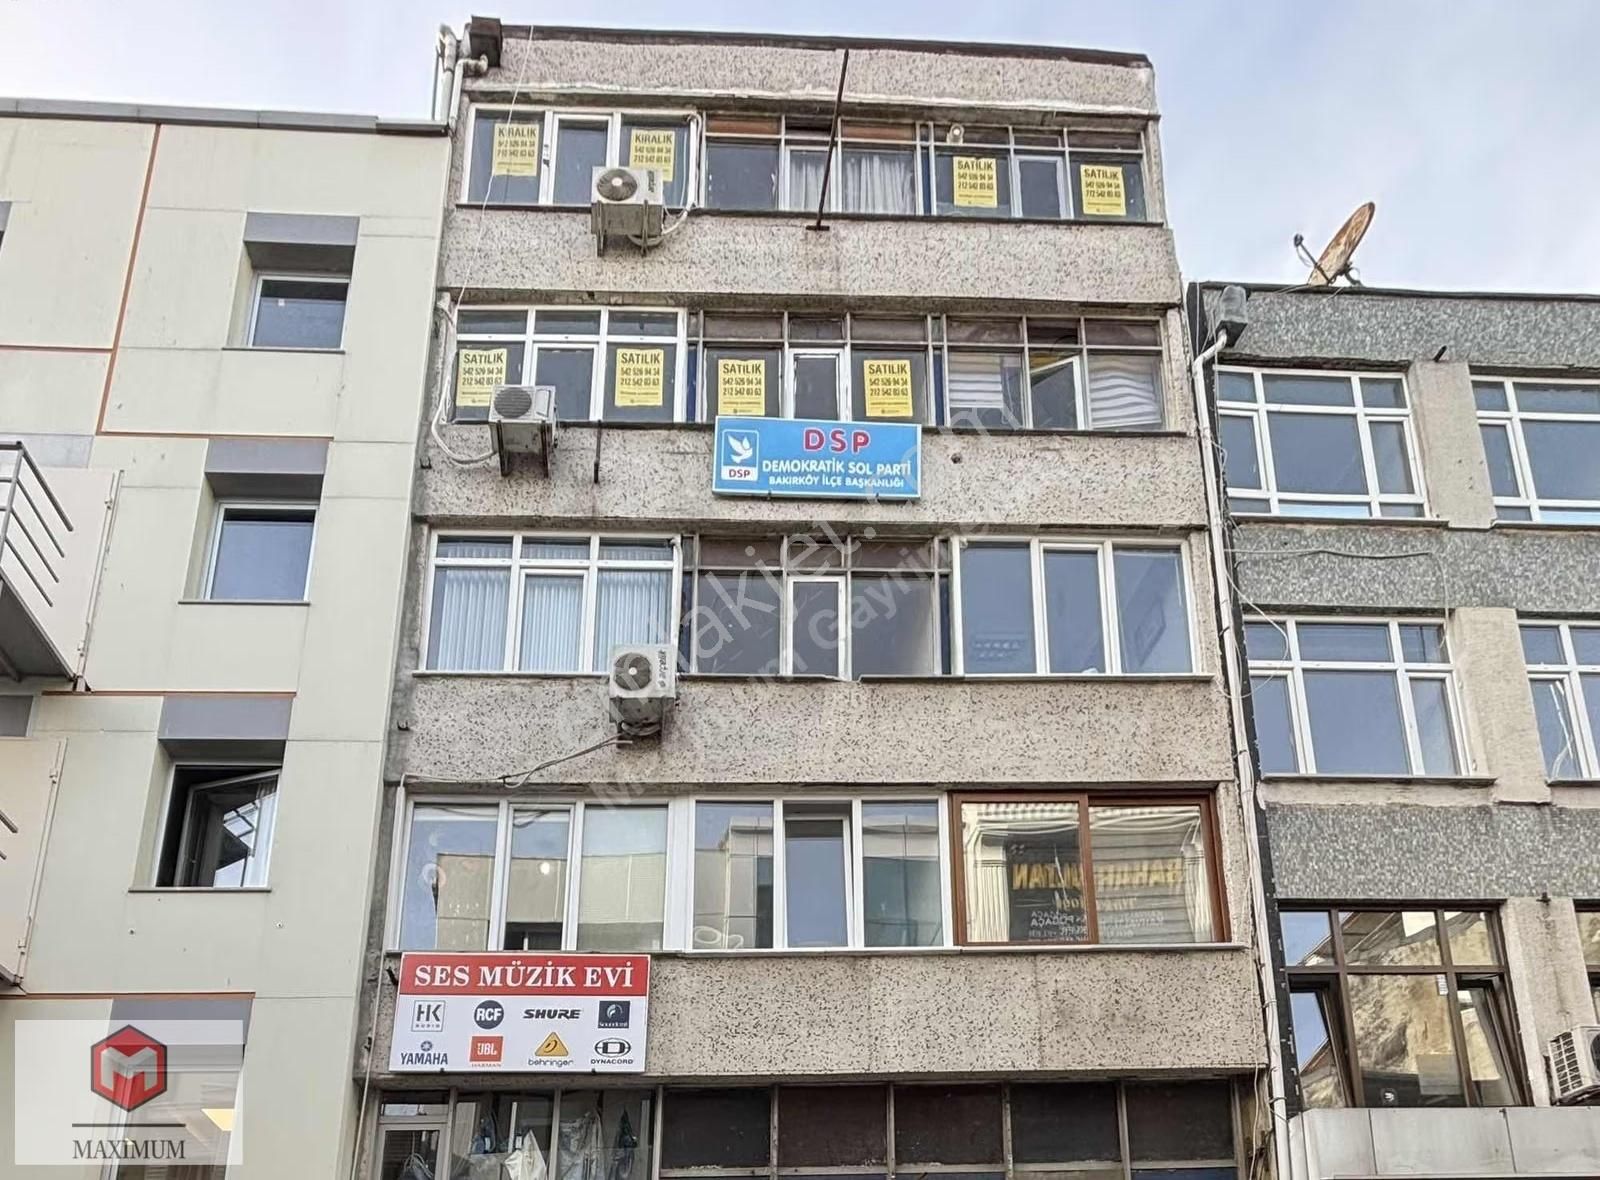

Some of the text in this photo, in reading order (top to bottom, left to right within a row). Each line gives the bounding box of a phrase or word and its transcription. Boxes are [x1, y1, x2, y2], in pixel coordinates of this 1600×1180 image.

[498, 127, 537, 138] KRALIK
[635, 133, 672, 144] KIRALIK
[958, 160, 993, 170] SATILIK
[1084, 168, 1119, 180] SATILIK
[463, 353, 504, 364] SATILIK
[621, 352, 660, 364] SATILIK
[723, 363, 761, 375] SATILIK
[869, 364, 907, 375] SATILIK
[804, 427, 870, 454] DSP
[762, 457, 911, 476] DEMOKRATİK SOL PARTİ
[728, 469, 751, 478] DSP
[769, 475, 904, 488] BAKIRKÖY İLÇE BAŞKANLIĞI
[414, 960, 634, 988] SES MÜZİK EVİ
[476, 1008, 502, 1021] RCF
[523, 1009, 582, 1019] SHURE
[477, 1043, 497, 1055] JBL
[400, 1052, 448, 1065] YAMAHA
[528, 1058, 574, 1067] behringer
